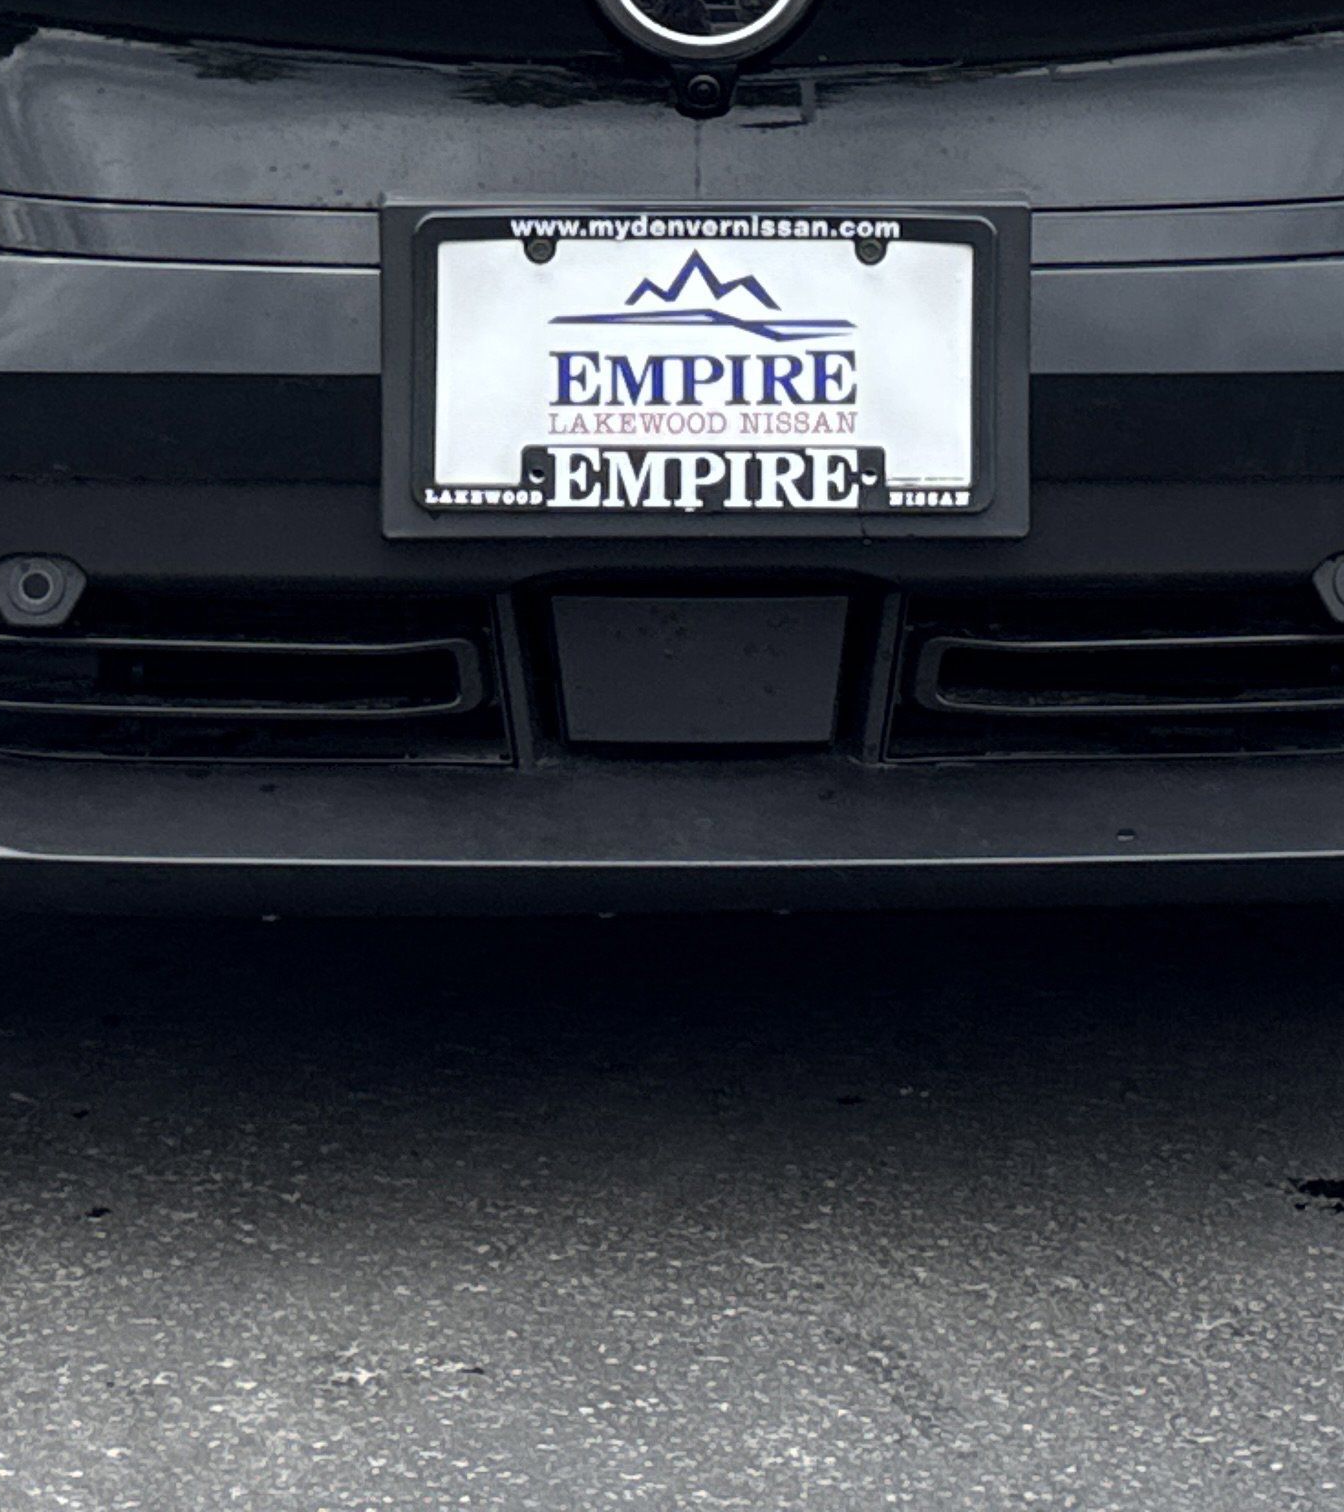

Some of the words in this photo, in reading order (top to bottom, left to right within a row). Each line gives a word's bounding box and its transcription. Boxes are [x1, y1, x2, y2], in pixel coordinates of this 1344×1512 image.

[510, 215, 900, 241] www.mydenvernissan.com
[549, 350, 857, 407] EMPIRE
[548, 411, 728, 435] LAKEWOOD
[739, 411, 858, 435] NISSAN
[546, 447, 859, 509] EMPIRE
[425, 489, 543, 505] LAKEWOOD
[889, 491, 970, 506] NISSAN
